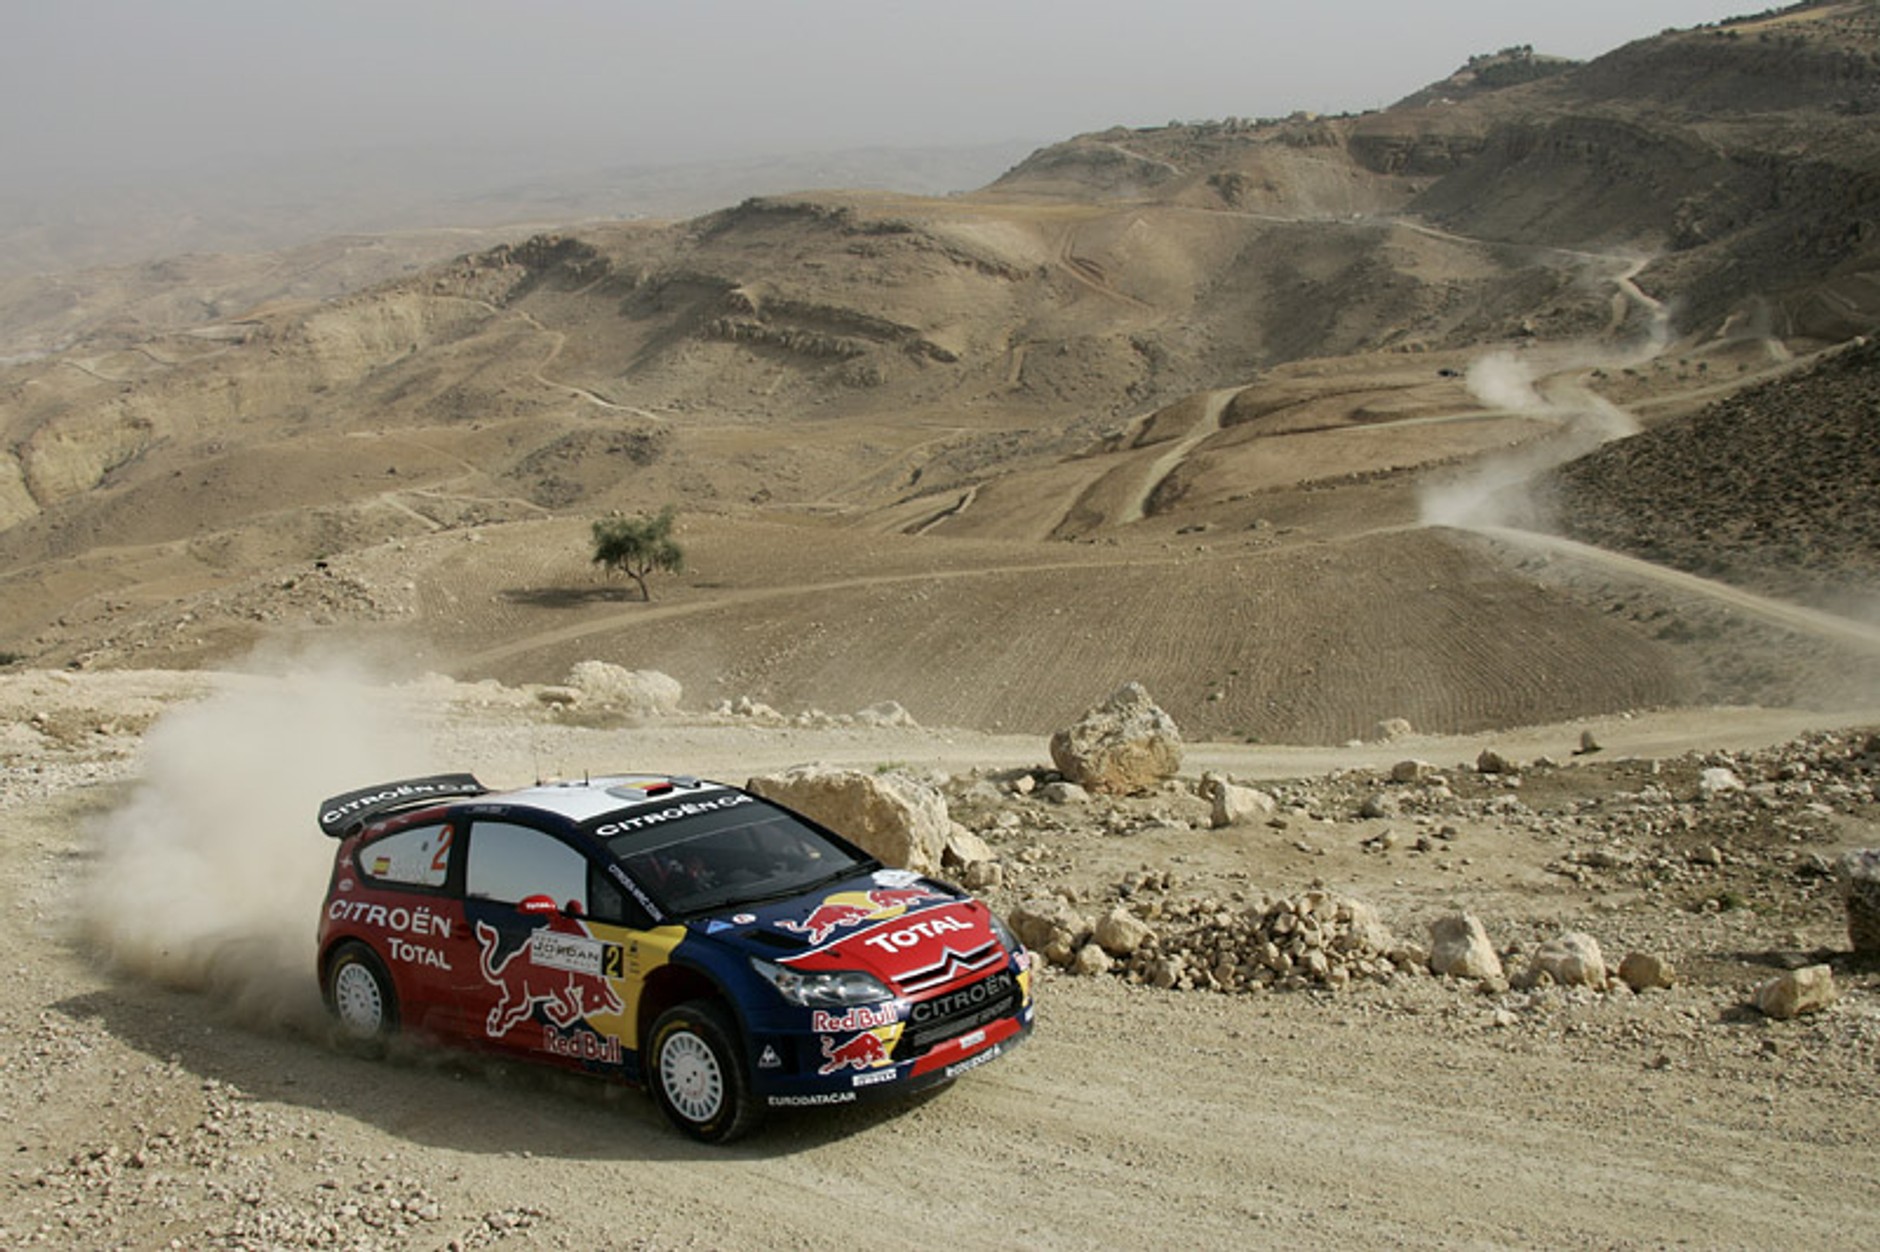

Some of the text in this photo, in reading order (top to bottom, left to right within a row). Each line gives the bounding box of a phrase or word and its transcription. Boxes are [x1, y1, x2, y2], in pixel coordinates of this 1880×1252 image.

[430, 823, 455, 870] 2
[329, 899, 452, 938] CITROËN
[864, 915, 974, 953] TOTAL
[387, 937, 452, 971] TOTAL
[606, 945, 620, 977] 2
[911, 971, 1013, 1021] CITROËN
[812, 1000, 899, 1032] Red Bull
[543, 1024, 624, 1065] Red Bull
